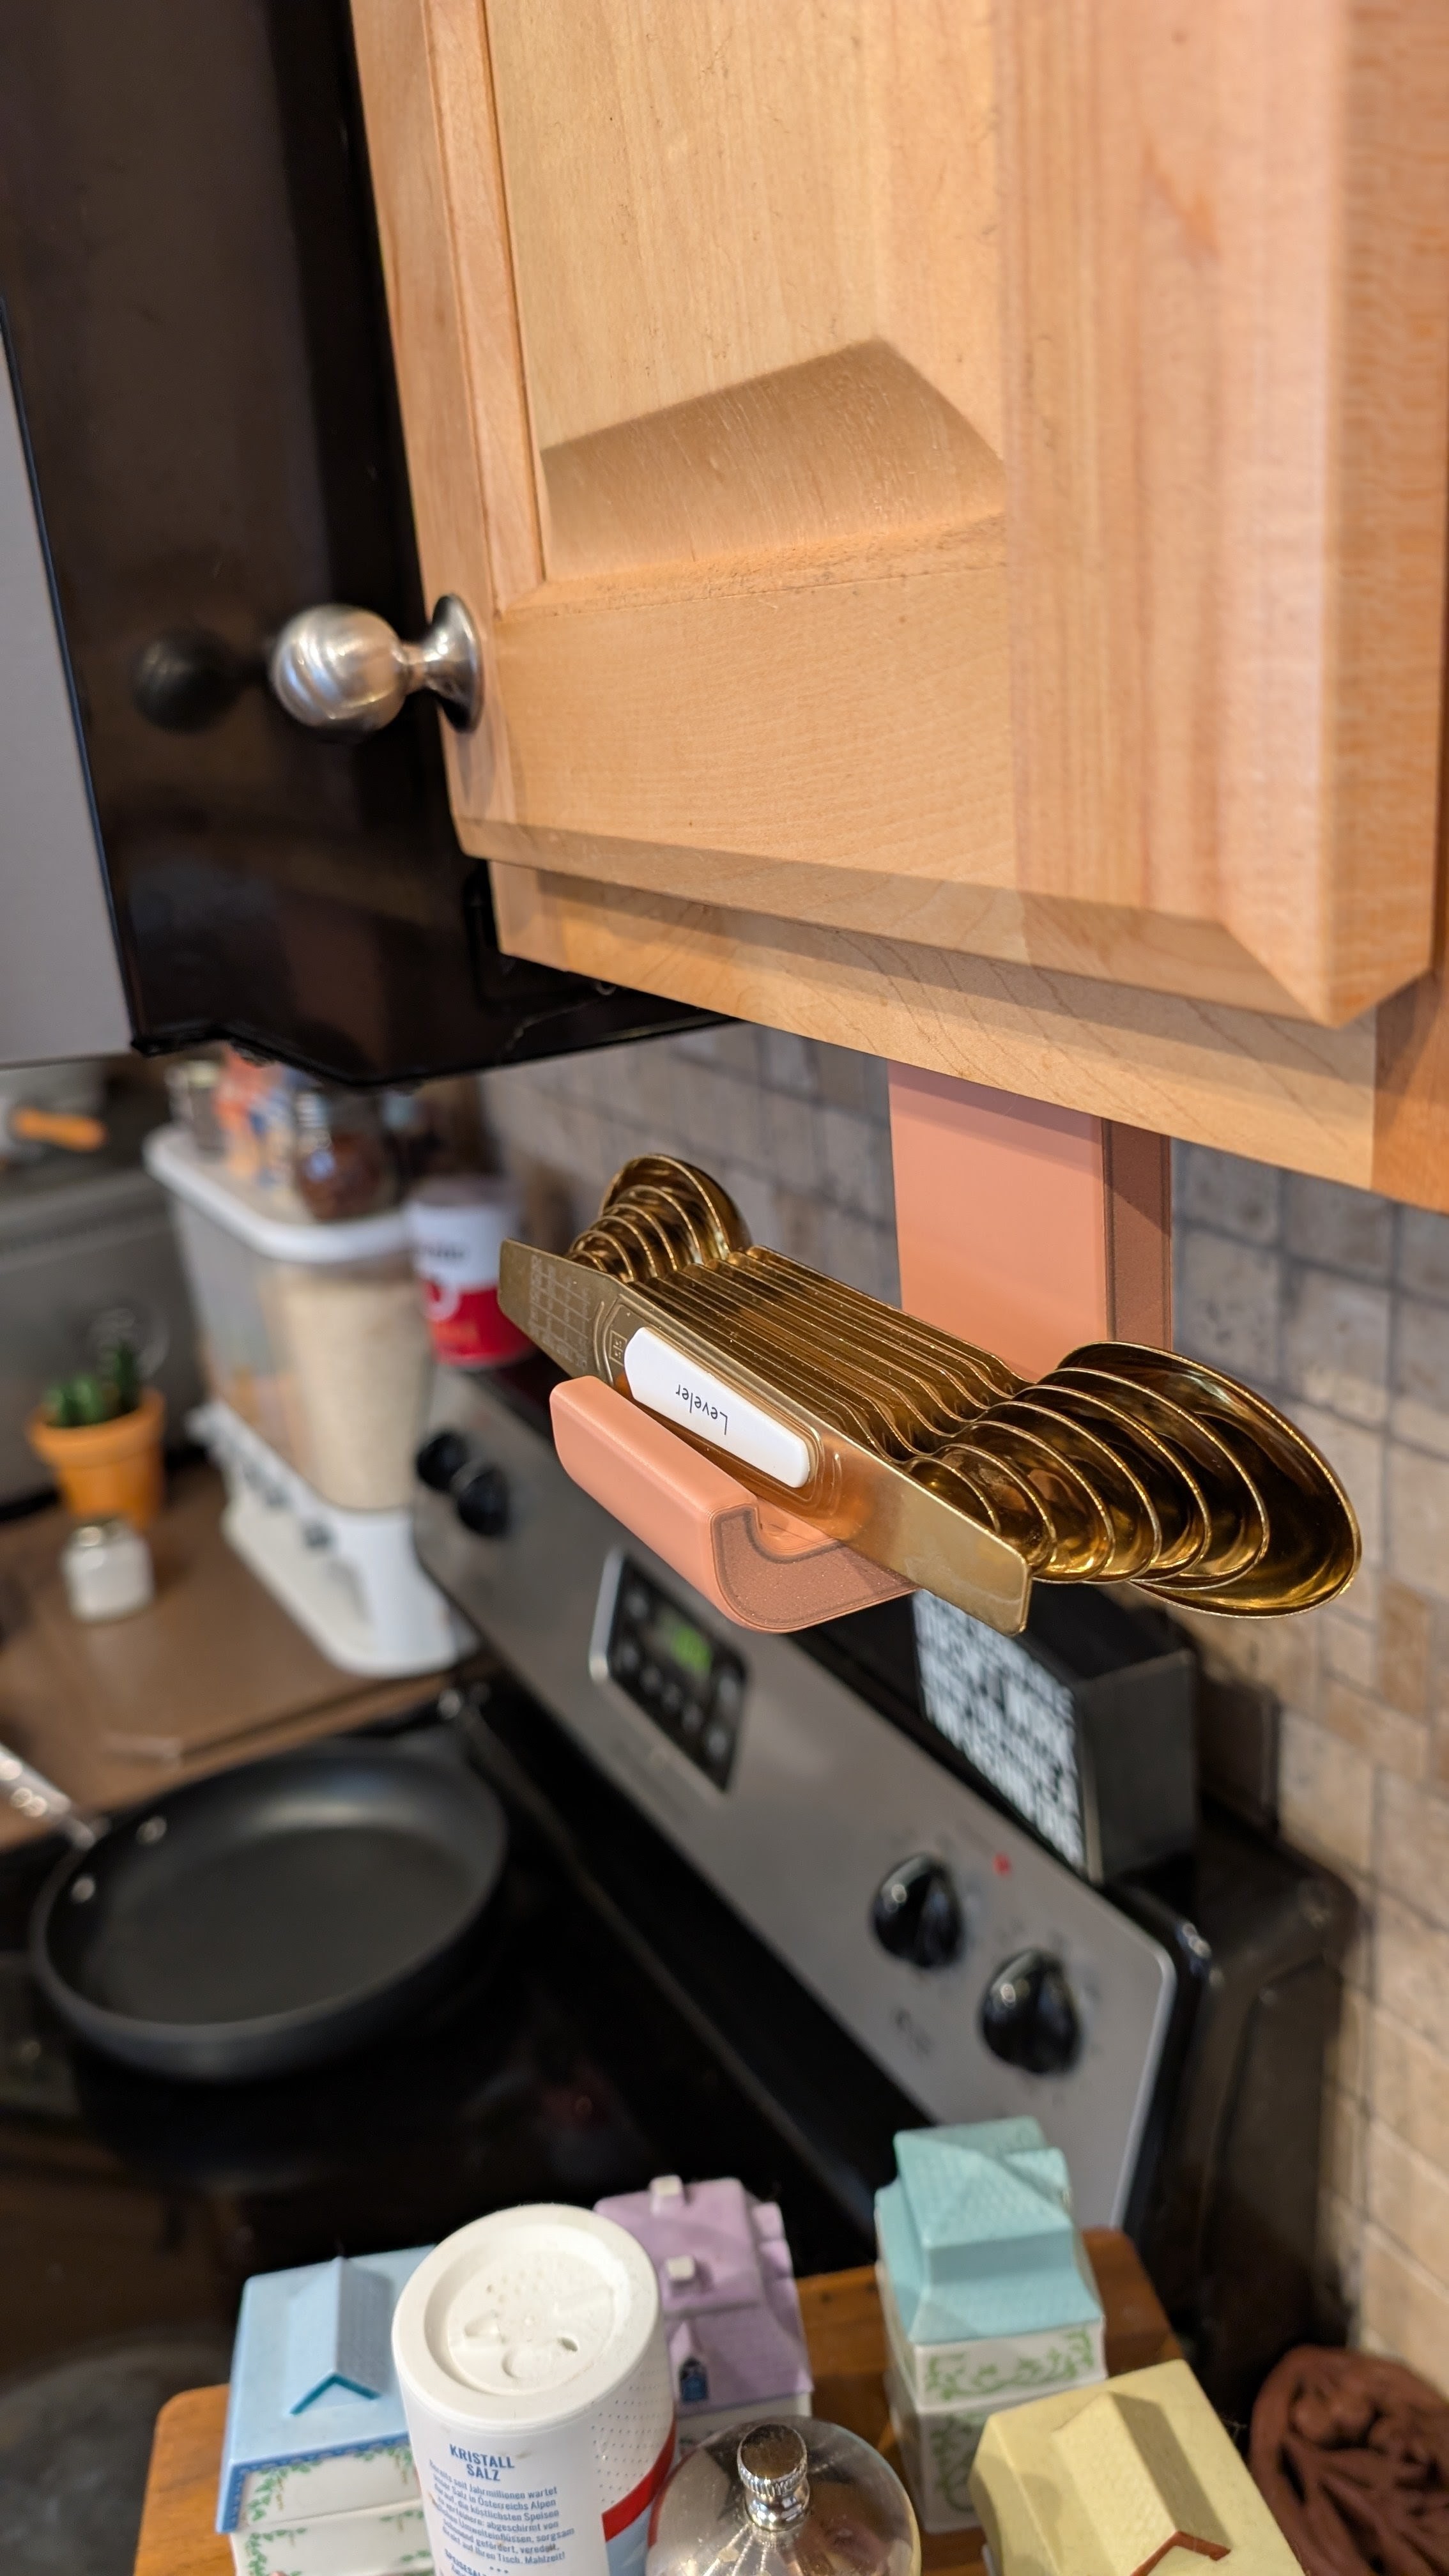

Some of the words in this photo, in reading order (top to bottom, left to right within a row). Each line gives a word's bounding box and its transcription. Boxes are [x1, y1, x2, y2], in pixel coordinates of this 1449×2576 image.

[675, 1384, 728, 1436] Leveler
[449, 2443, 514, 2469] KRISTALL
[466, 2463, 500, 2481] SALZ
[452, 2485, 467, 2500] Salz
[469, 2494, 477, 2503] in
[478, 2494, 529, 2510] Österreichs
[531, 2499, 556, 2510] Alpen
[454, 2478, 468, 2490] seit
[470, 2483, 525, 2499] Jahrmillionen
[528, 2486, 557, 2499] wartet
[470, 2504, 522, 2521] köstlichsten
[524, 2510, 559, 2522] Speisen
[486, 2521, 540, 2532] abgeschirmt
[543, 2521, 558, 2530] von
[536, 2527, 575, 2542] sorgsam
[476, 2538, 519, 2554] gefördert,
[525, 2551, 565, 2564] Mahlzeit!
